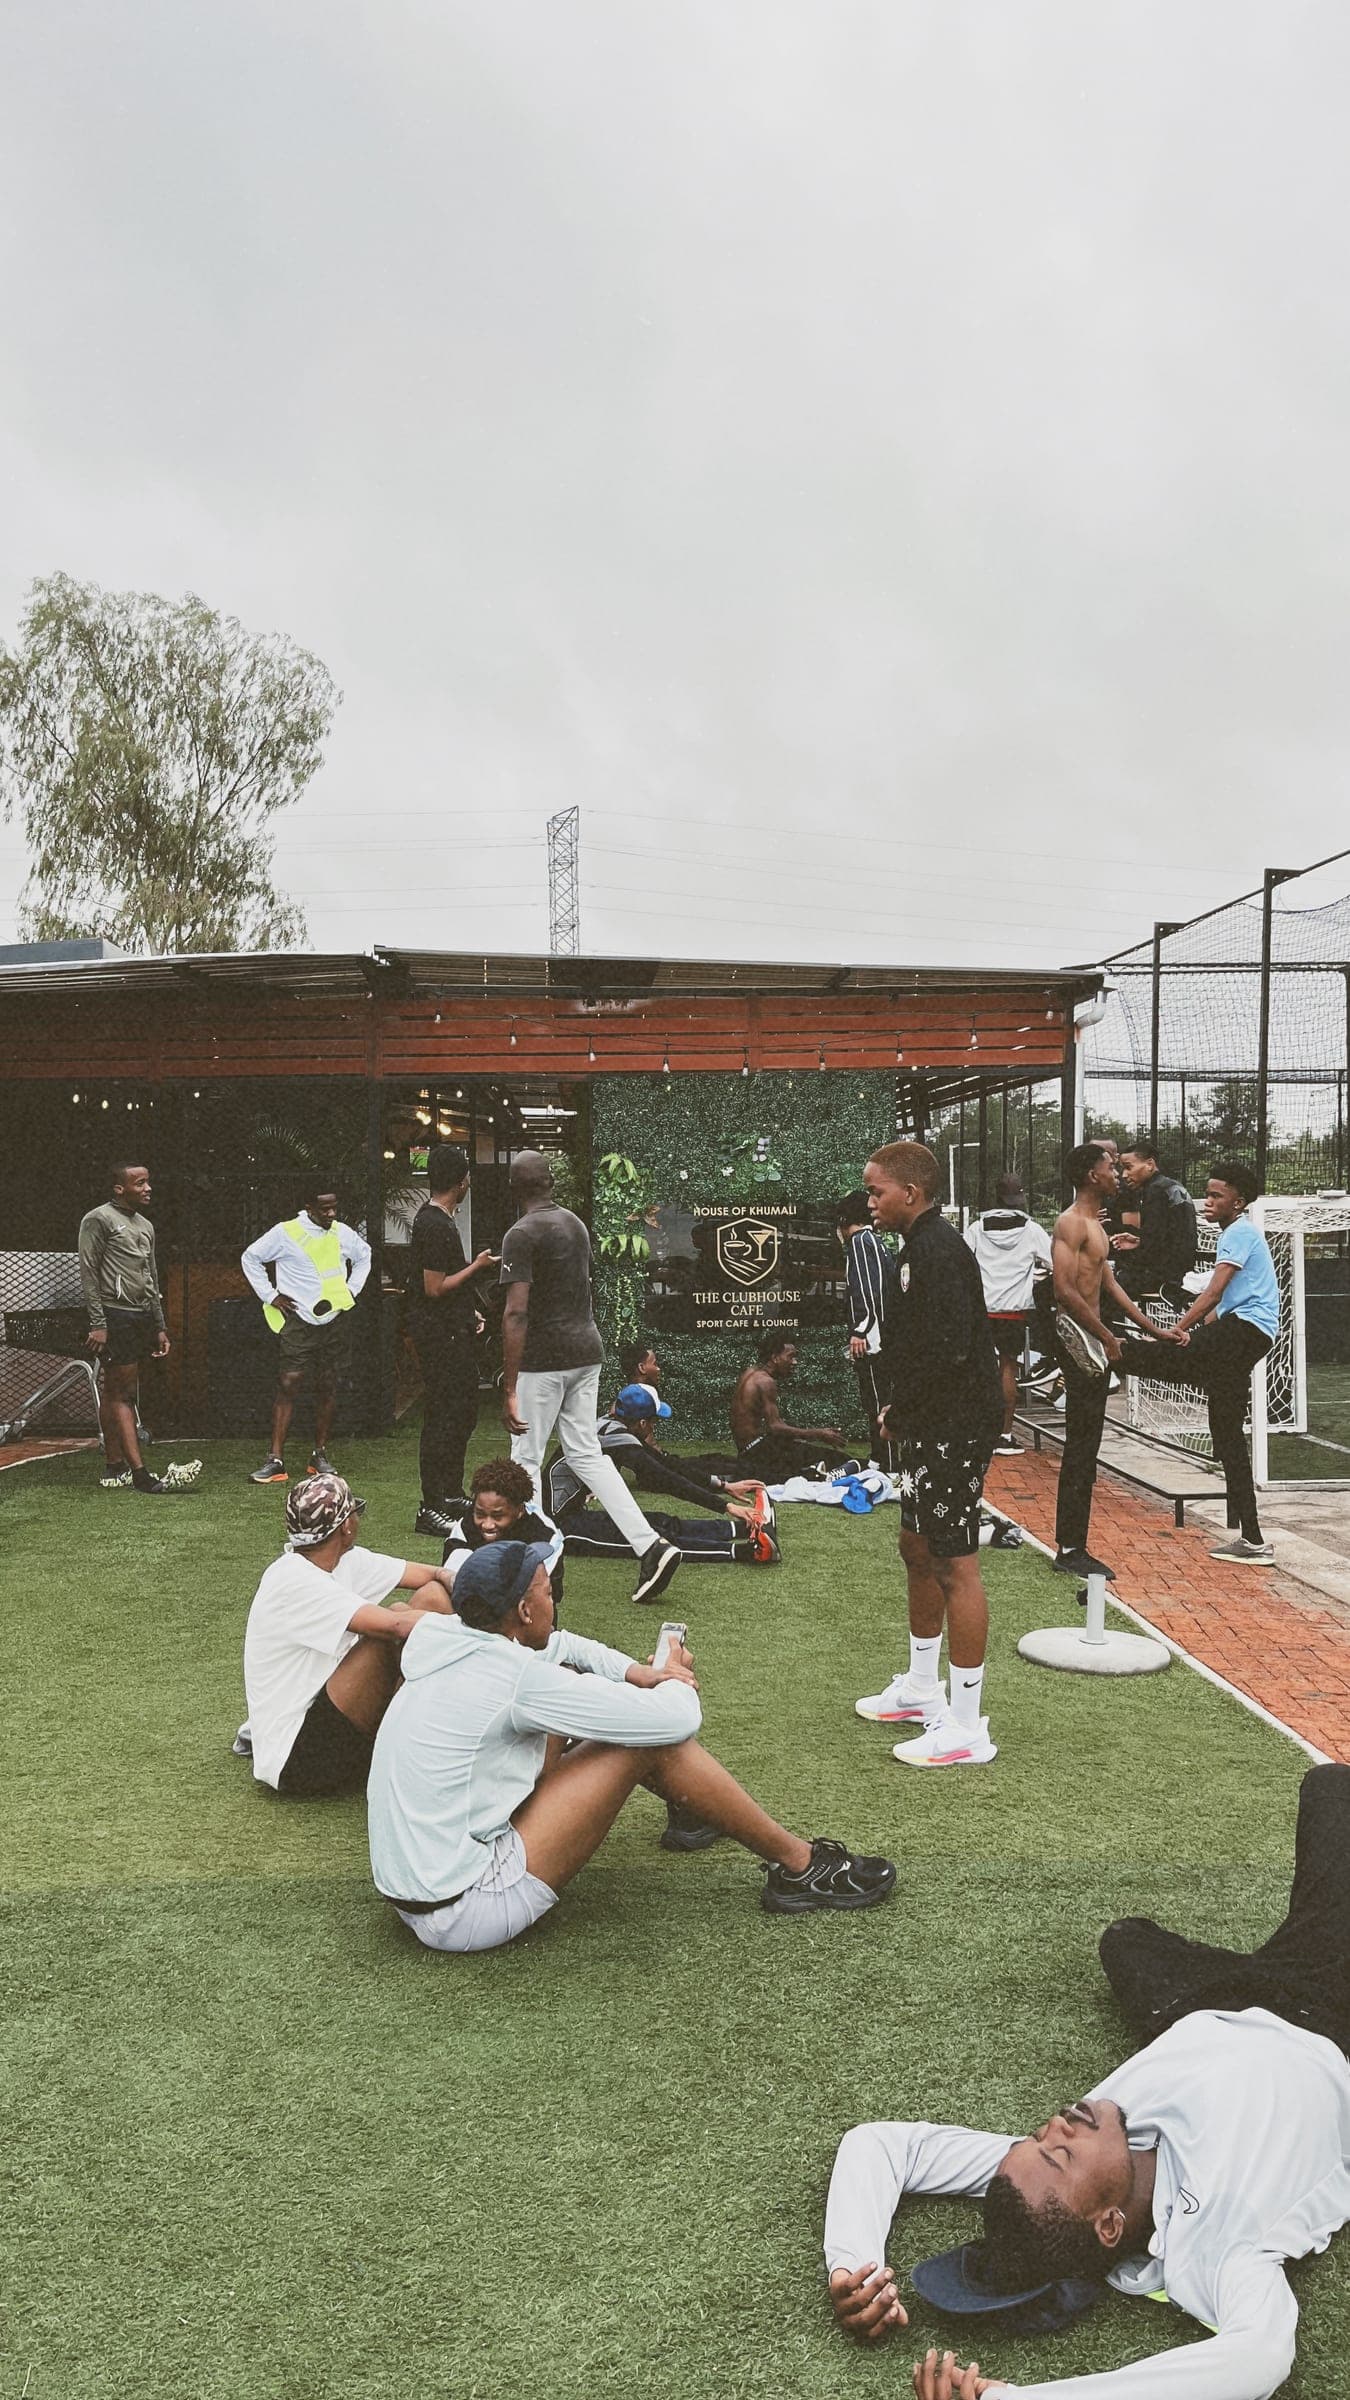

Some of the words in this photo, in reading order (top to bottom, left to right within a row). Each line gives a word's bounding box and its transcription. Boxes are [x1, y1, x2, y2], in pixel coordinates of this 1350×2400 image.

[693, 1206, 729, 1217] HOUSE
[731, 1206, 747, 1216] OF
[749, 1205, 797, 1216] KHUMALI
[692, 1292, 720, 1304] THE
[722, 1291, 801, 1303] CLUBHOUSE
[730, 1304, 764, 1316] CAFE
[696, 1319, 723, 1328] SPORT
[725, 1319, 749, 1327] CAFE
[753, 1319, 760, 1327] &
[761, 1319, 799, 1327] LOUNGE
